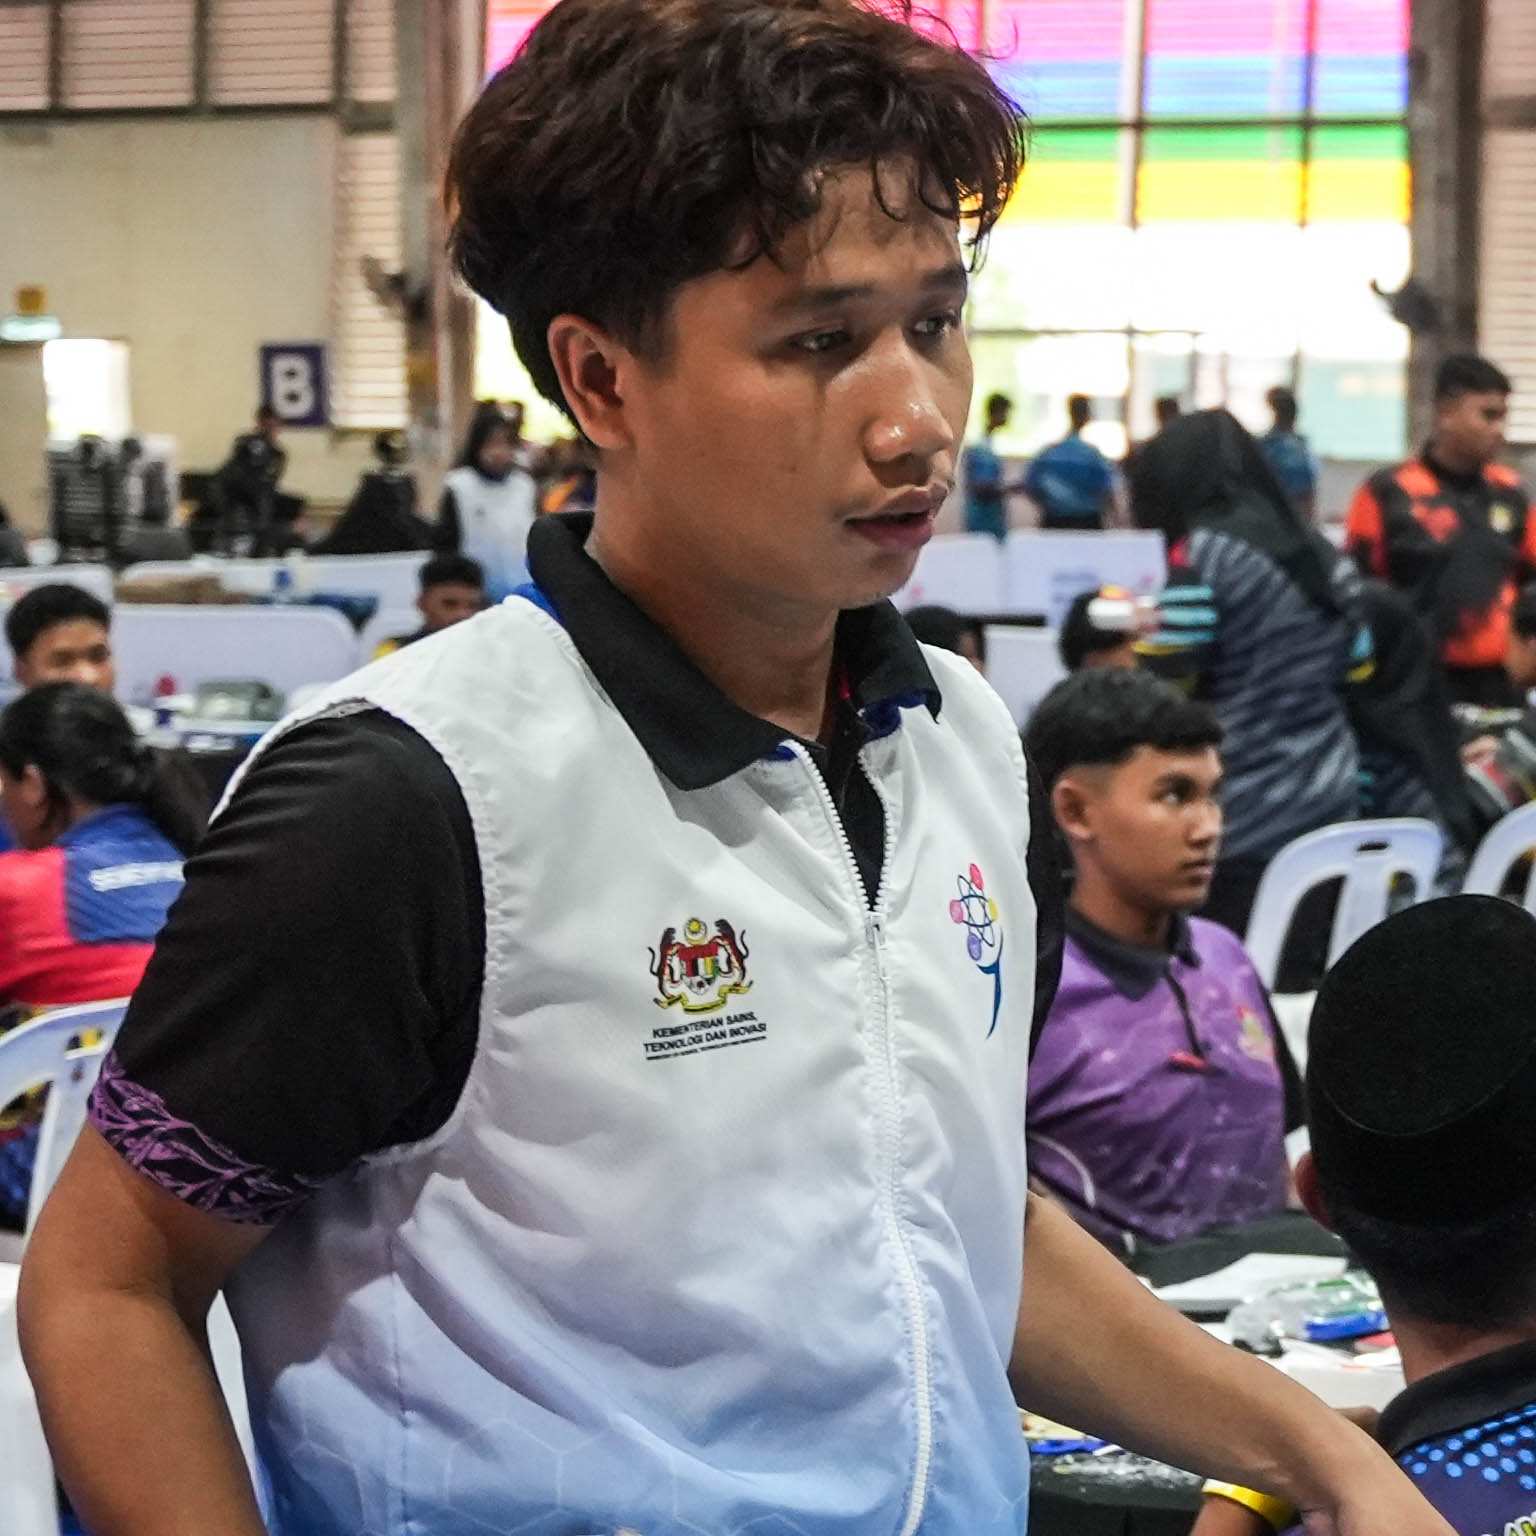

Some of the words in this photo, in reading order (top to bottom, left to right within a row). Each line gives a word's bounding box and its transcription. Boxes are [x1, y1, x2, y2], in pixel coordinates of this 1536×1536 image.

[271, 352, 315, 419] B
[643, 1034, 704, 1053] TEKNOLOGI
[705, 1029, 728, 1042] DAN
[729, 1023, 767, 1037] INOVASI
[653, 1017, 723, 1039] KEMENTERIAN
